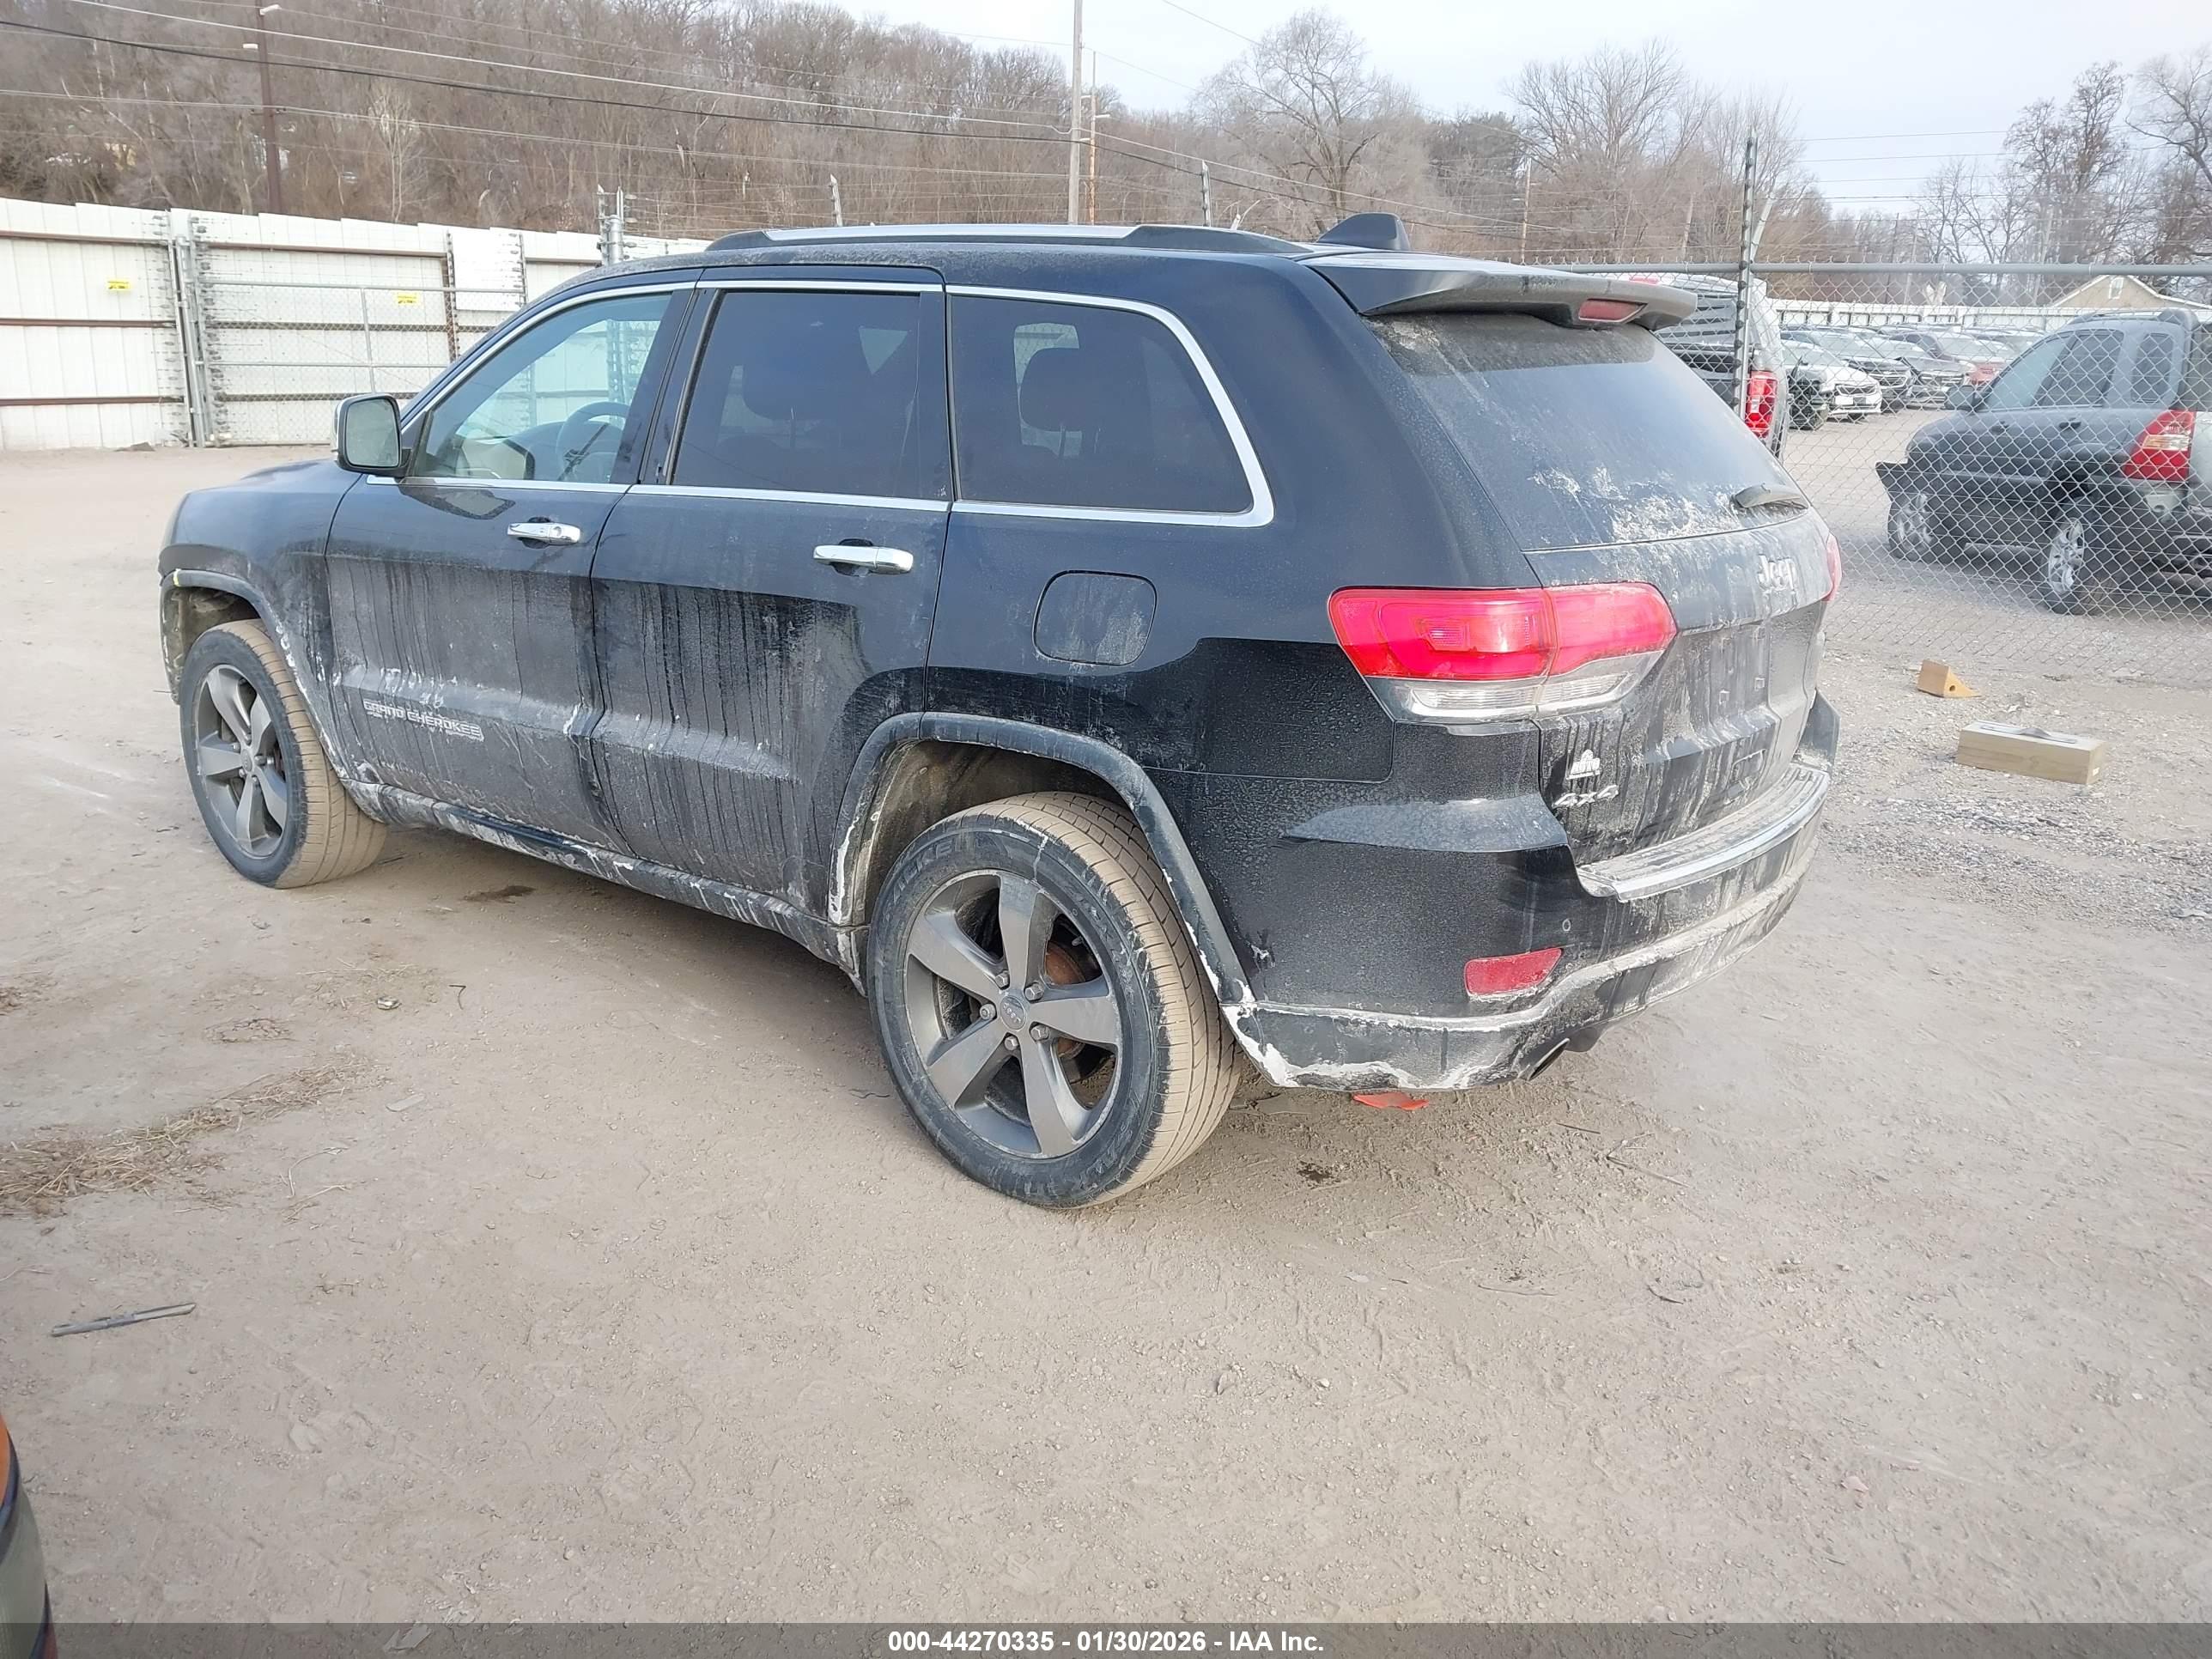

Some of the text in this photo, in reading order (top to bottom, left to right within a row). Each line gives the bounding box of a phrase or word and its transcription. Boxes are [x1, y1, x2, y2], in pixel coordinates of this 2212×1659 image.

[1758, 555, 1796, 591] Jeep
[363, 700, 483, 738] GRAND CHEROKEE
